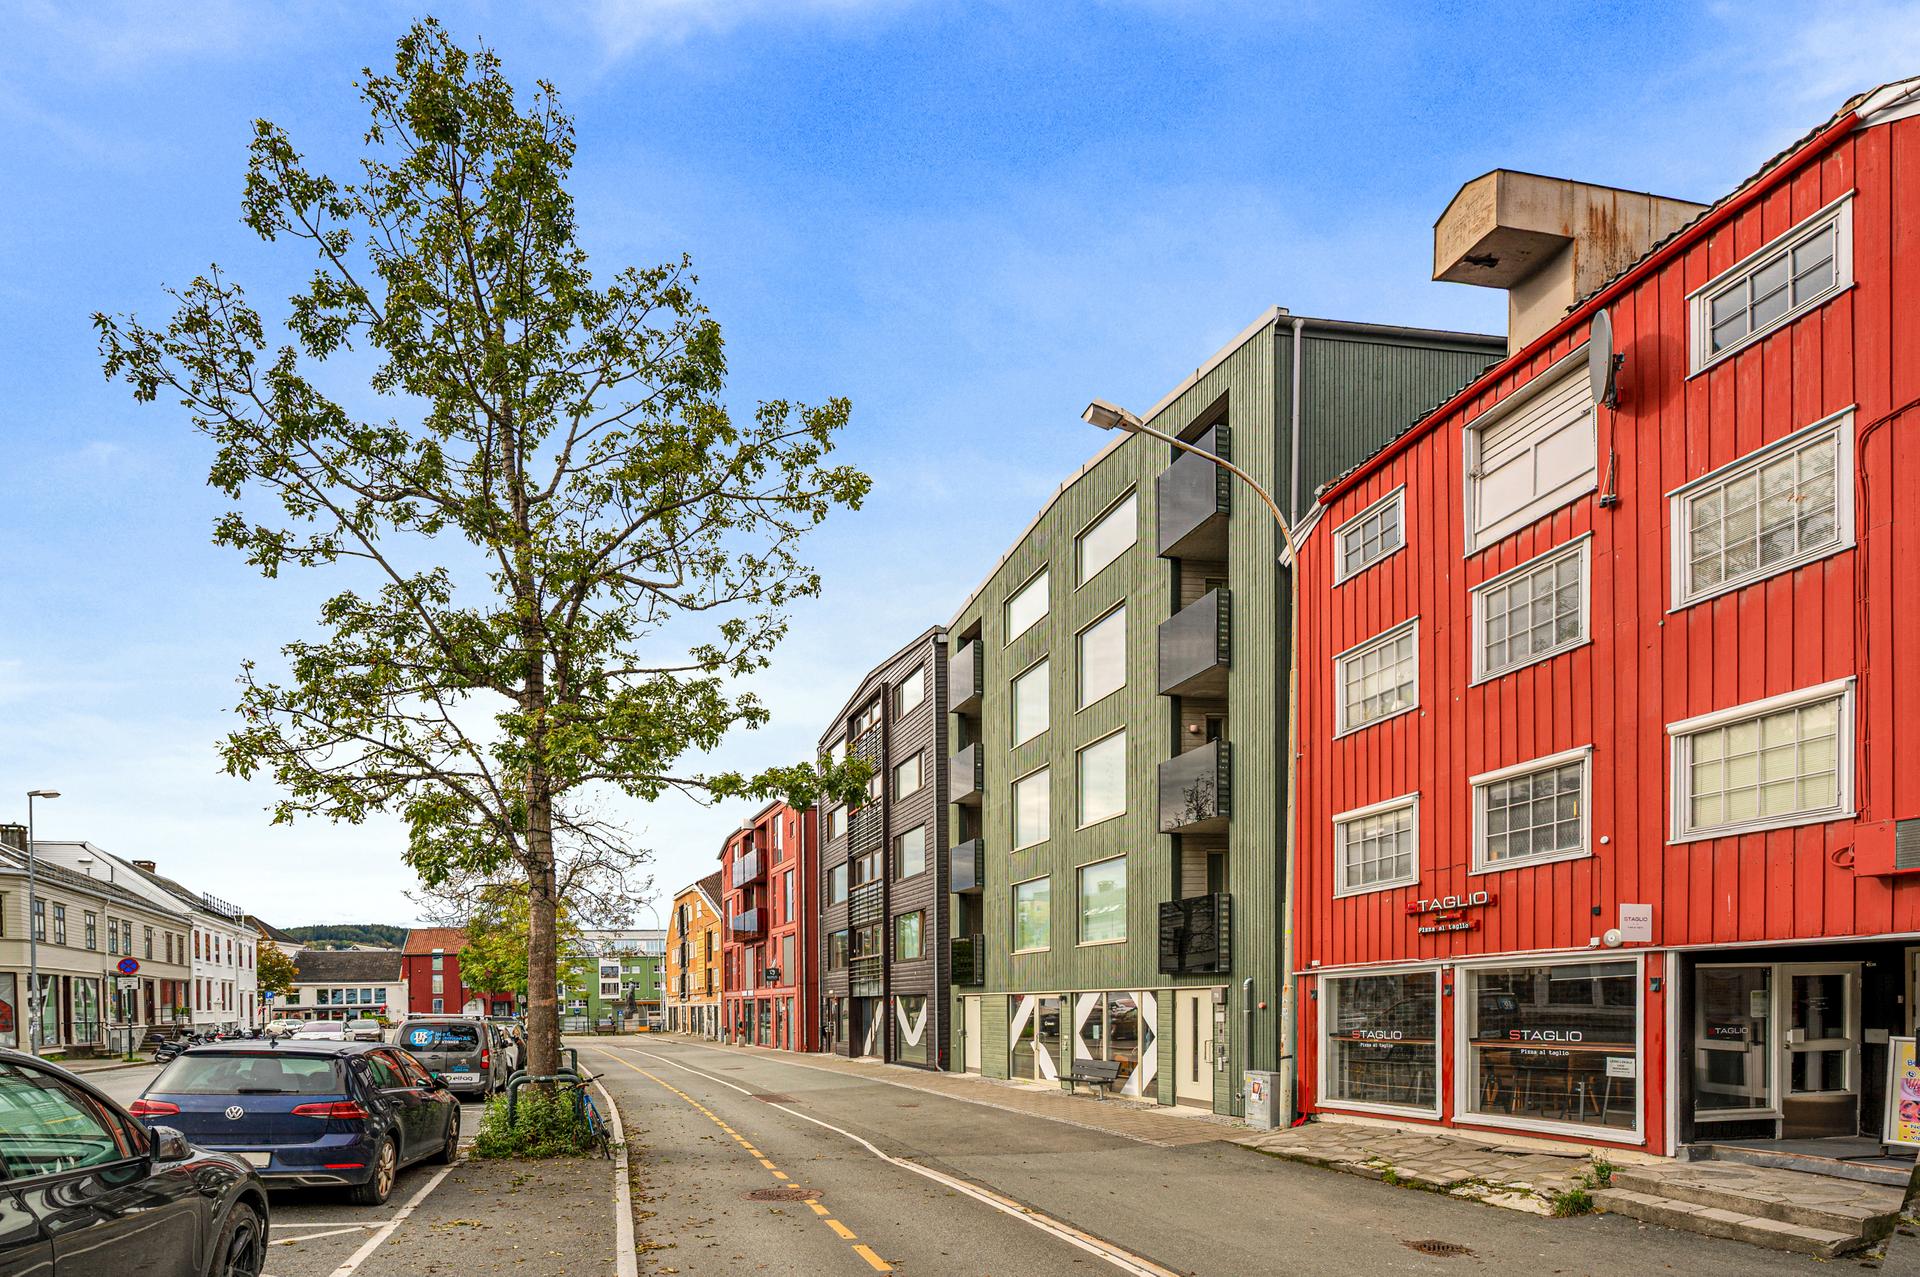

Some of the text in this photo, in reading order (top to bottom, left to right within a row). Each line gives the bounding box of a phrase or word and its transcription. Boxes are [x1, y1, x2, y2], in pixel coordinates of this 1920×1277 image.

[1406, 891, 1488, 913] STAGLIO
[1352, 1030, 1402, 1040] STAGLIO
[1509, 1029, 1583, 1042] STAGLIO
[1549, 1049, 1570, 1057] taglio
